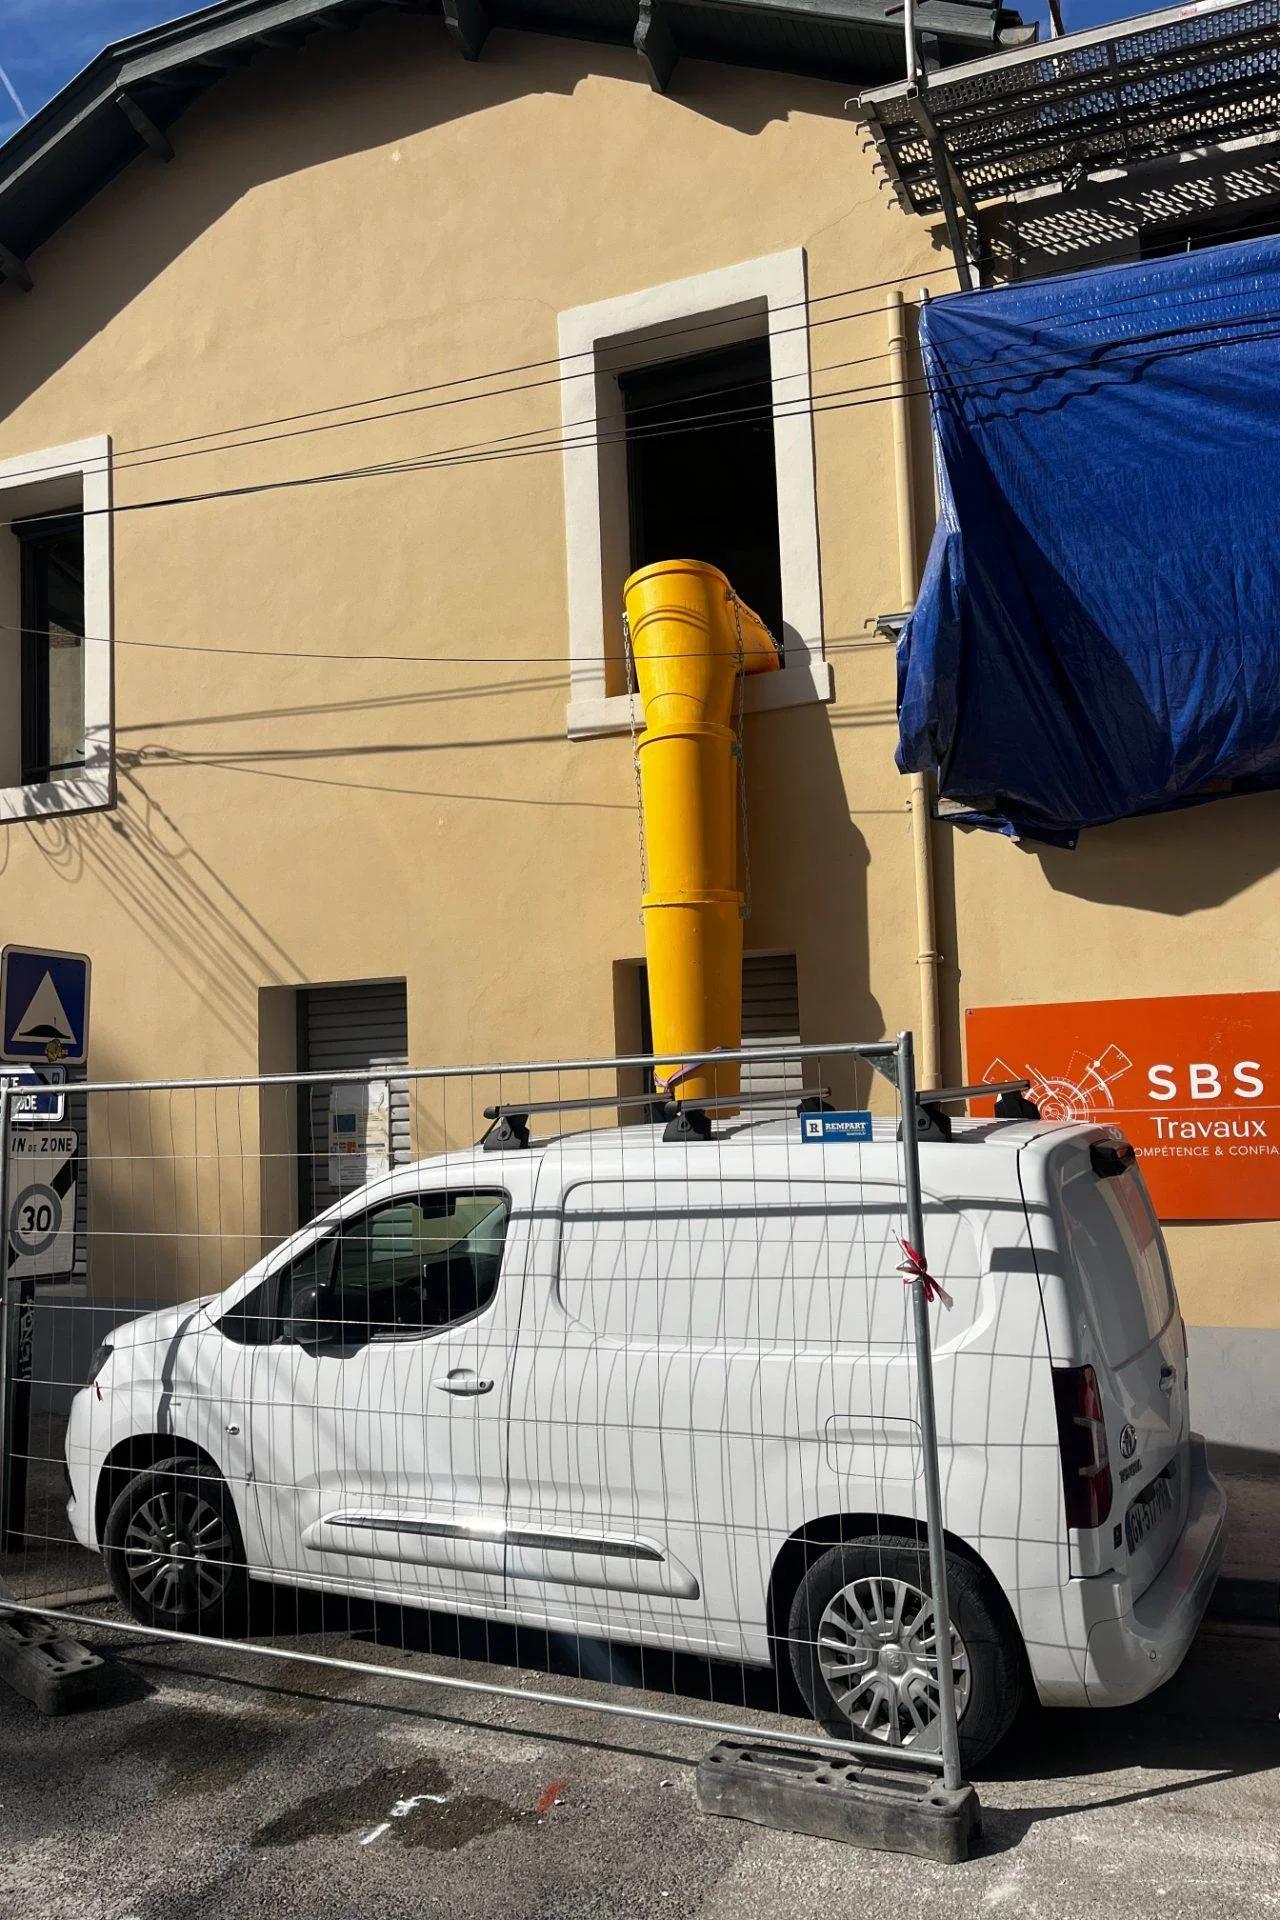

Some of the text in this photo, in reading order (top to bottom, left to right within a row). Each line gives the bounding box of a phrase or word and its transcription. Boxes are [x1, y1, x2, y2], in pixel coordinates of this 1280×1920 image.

[1147, 1060, 1264, 1101] SBS
[809, 1122, 820, 1133] R
[825, 1122, 866, 1131] REMPART
[1150, 1116, 1267, 1139] Travaux
[11, 1137, 26, 1152] IN
[40, 1137, 73, 1152] ZONE
[1133, 1145, 1280, 1158] OMPÉTENCE & CONFIA
[20, 1205, 52, 1235] 30
